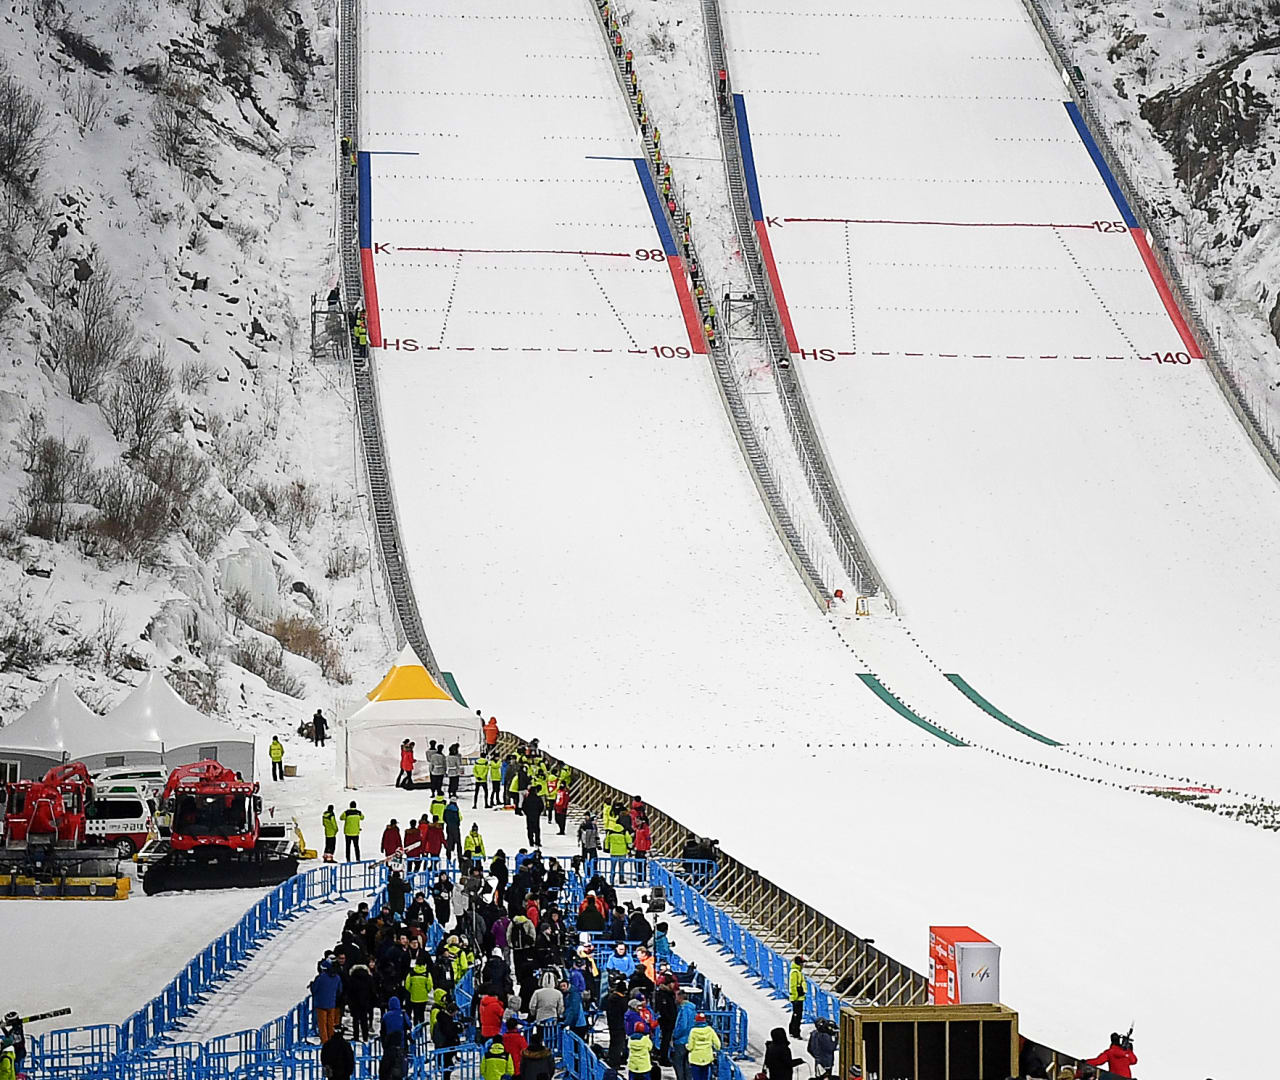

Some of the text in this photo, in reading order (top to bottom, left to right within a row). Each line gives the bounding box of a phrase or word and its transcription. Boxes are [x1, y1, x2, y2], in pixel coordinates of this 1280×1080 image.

[766, 216, 783, 228] K
[1092, 221, 1127, 233] 125
[374, 242, 391, 254] K
[635, 249, 665, 262] 98
[383, 338, 420, 352] HS
[650, 346, 691, 359] 109
[800, 348, 836, 362] HS
[1151, 352, 1192, 365] 140
